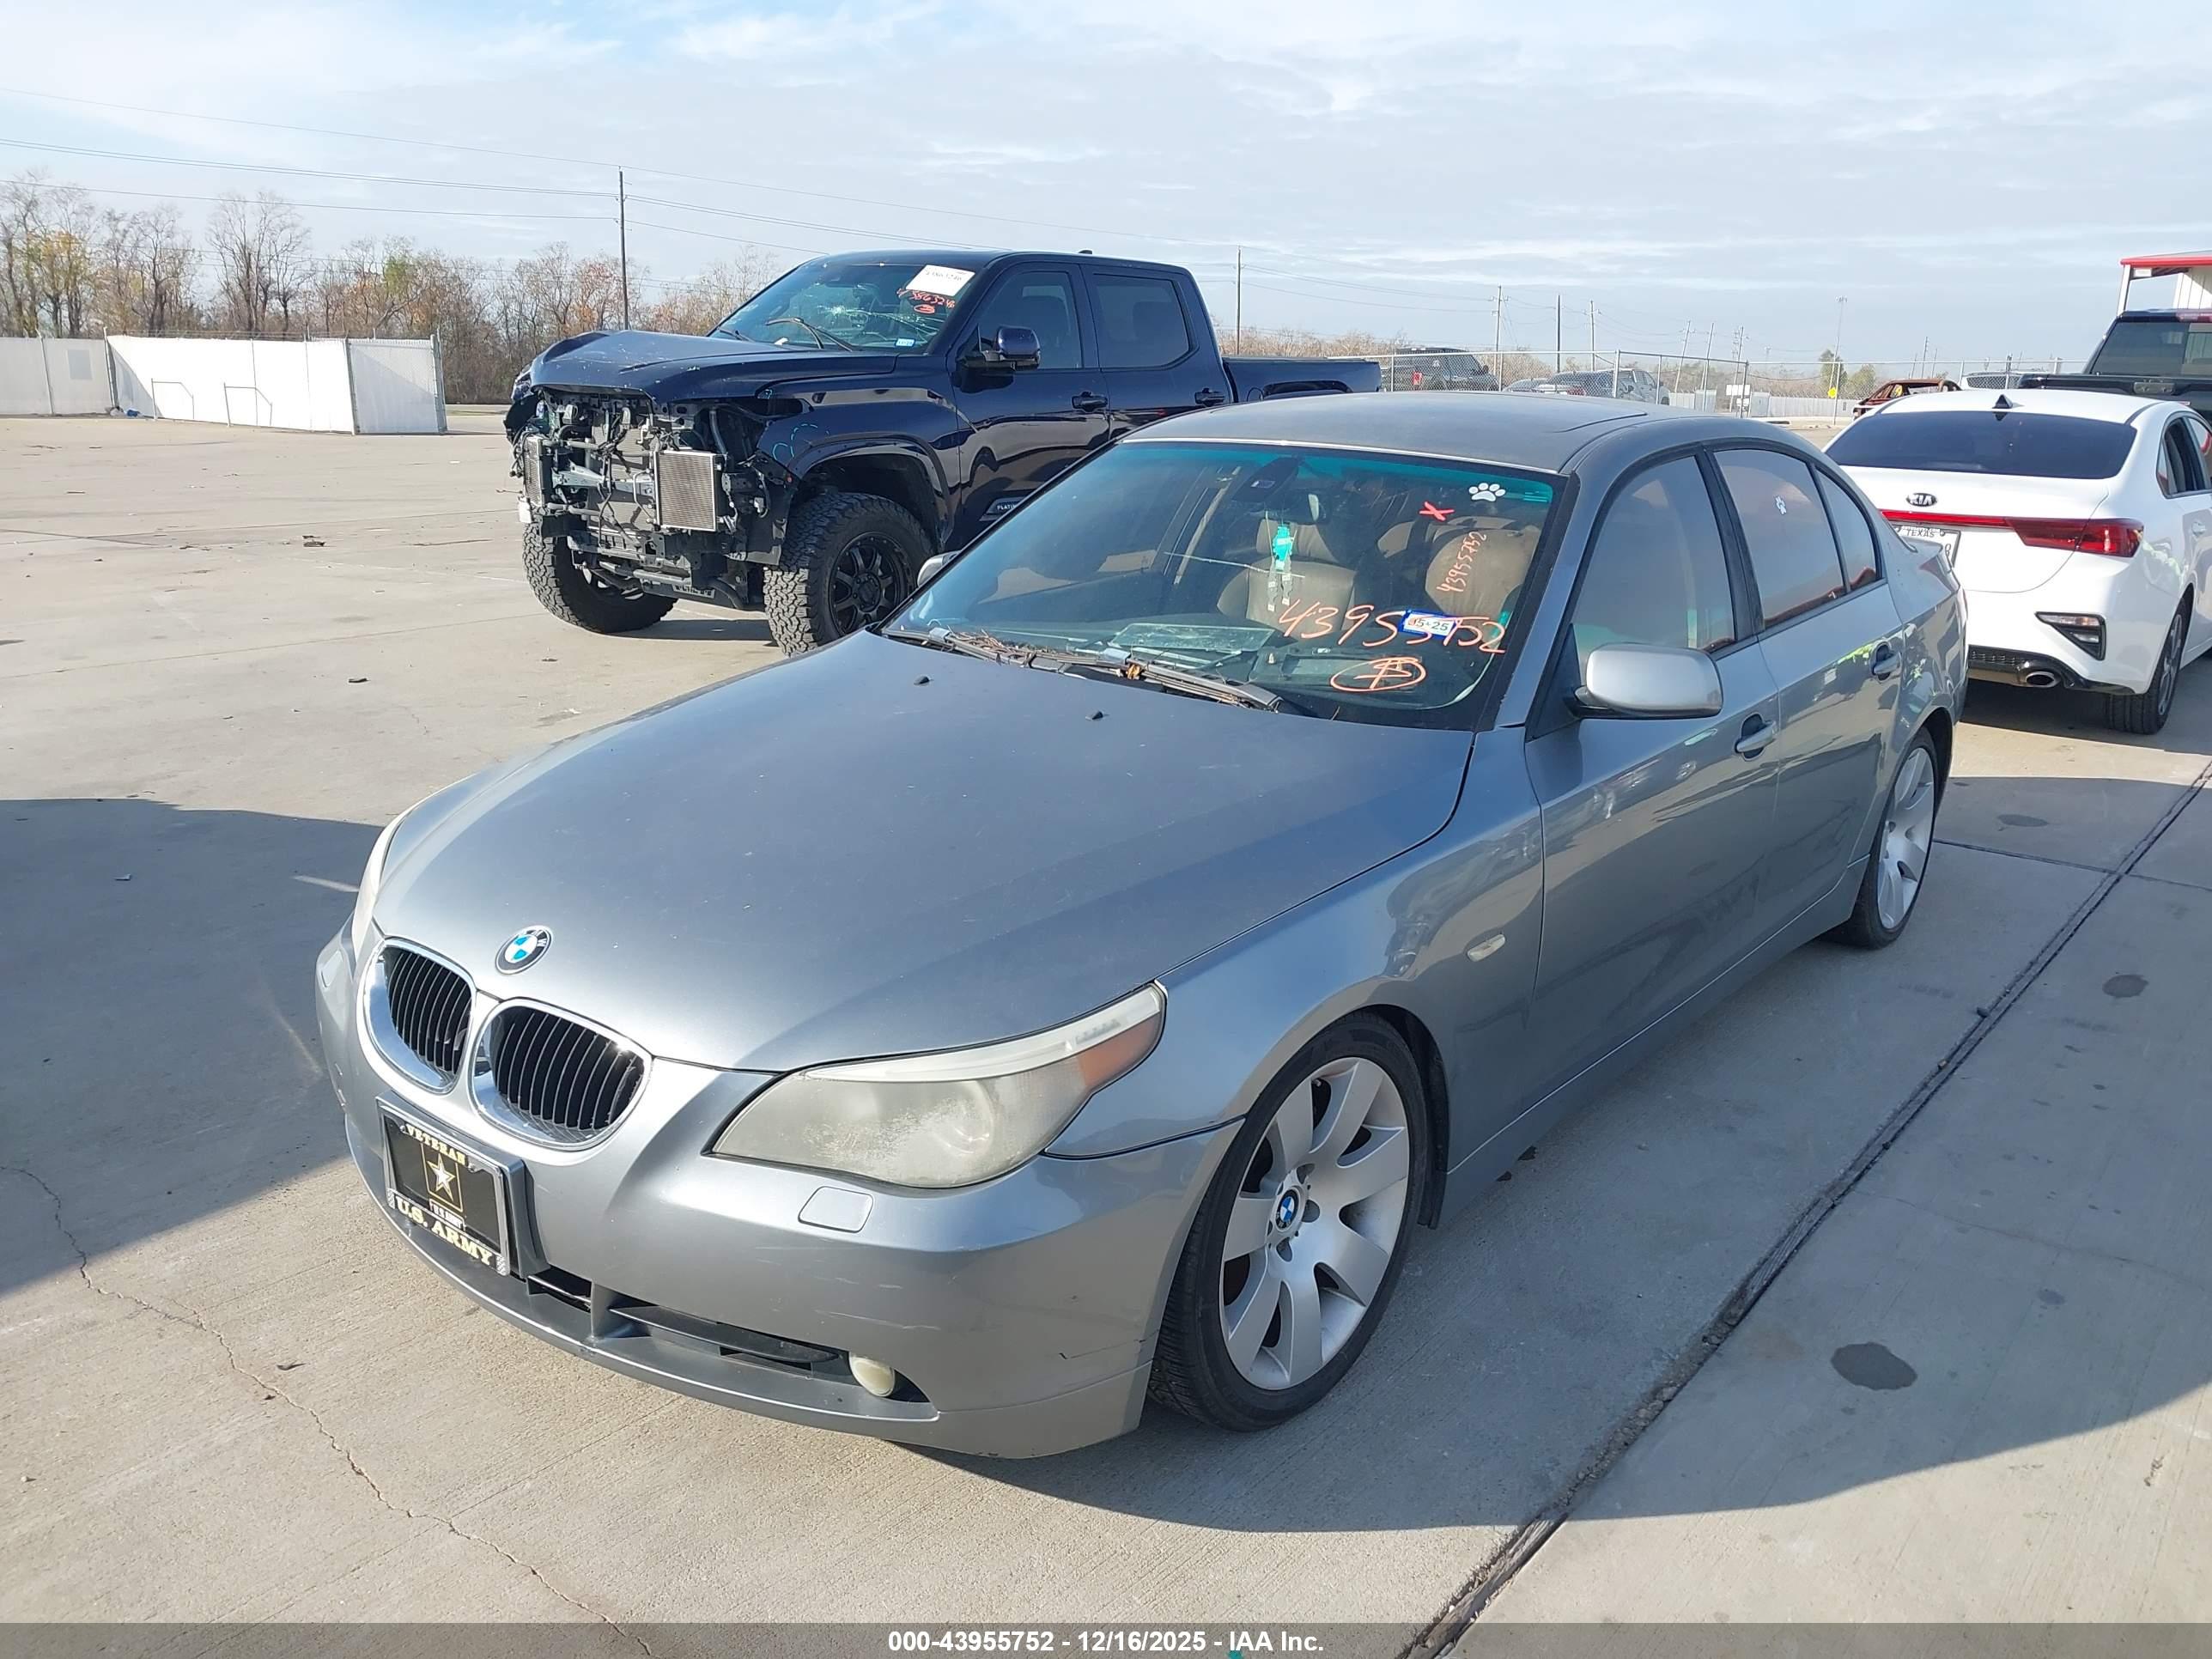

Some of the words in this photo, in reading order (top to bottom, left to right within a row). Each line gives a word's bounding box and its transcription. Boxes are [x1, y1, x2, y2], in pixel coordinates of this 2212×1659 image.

[1909, 494, 1932, 505] KIA
[1905, 527, 1936, 538] TEXAS
[404, 1123, 466, 1166] VETERAN
[396, 1198, 428, 1228] U.S.
[431, 1220, 493, 1266] ARMY
